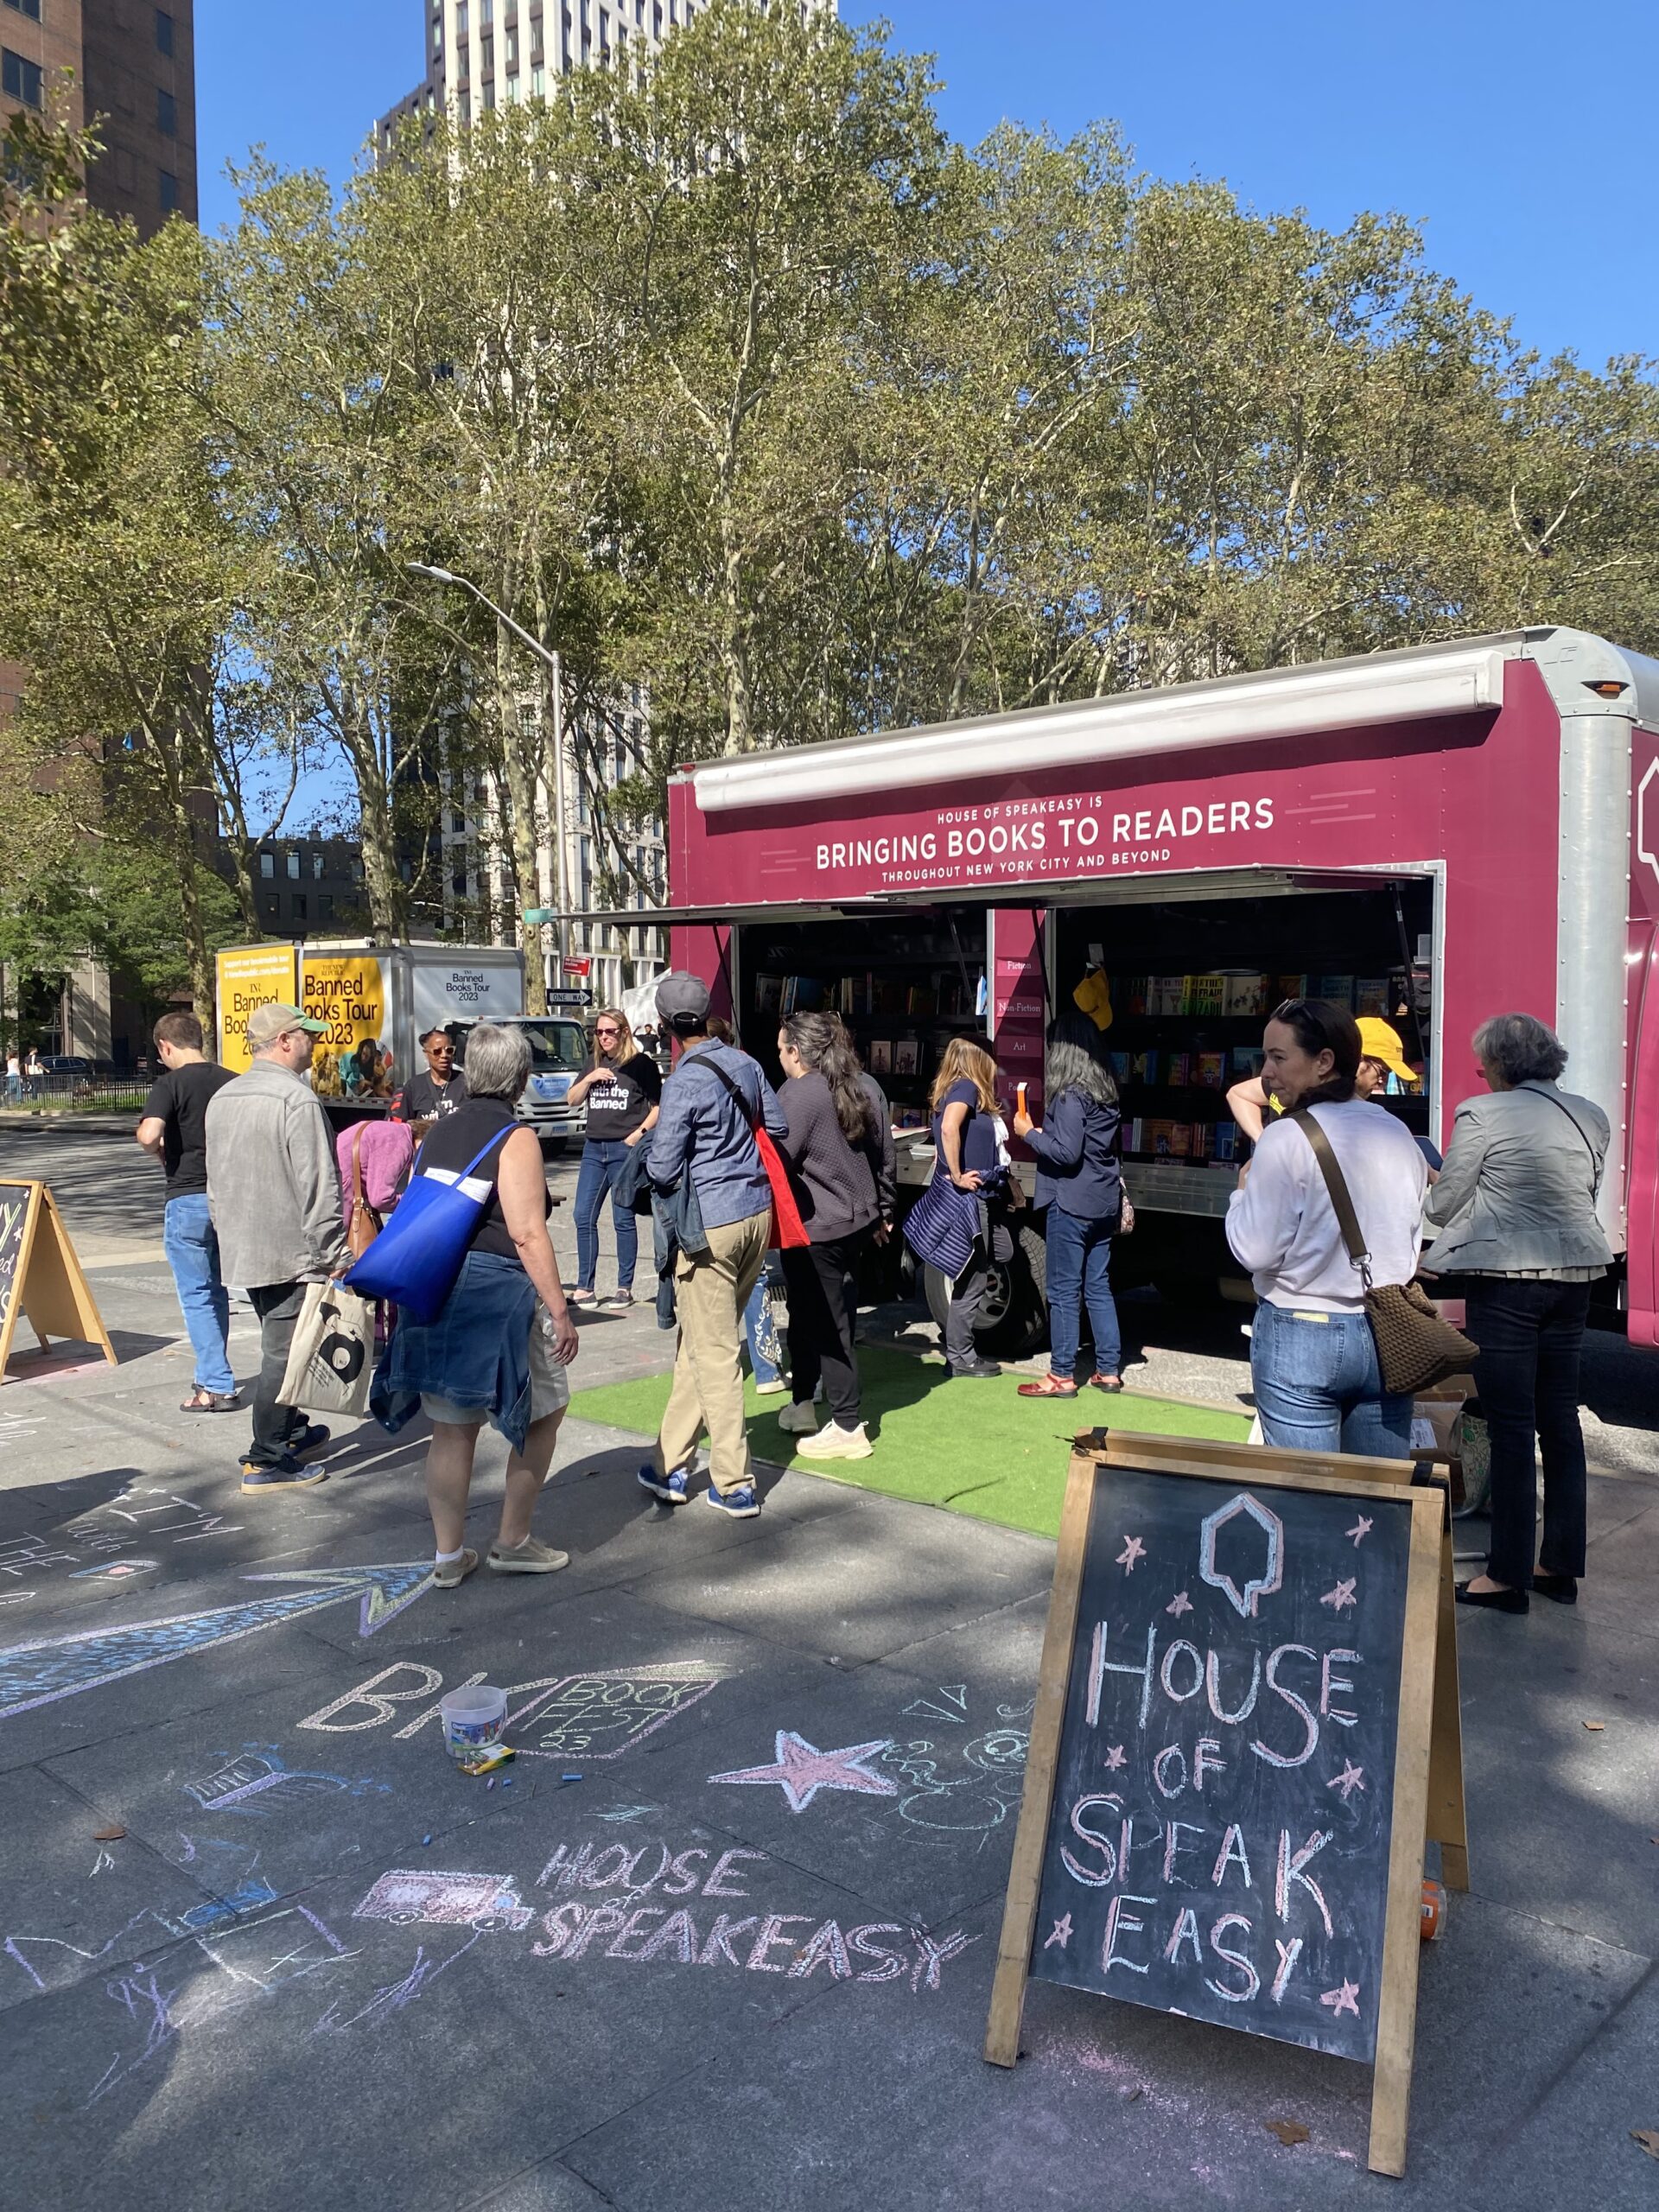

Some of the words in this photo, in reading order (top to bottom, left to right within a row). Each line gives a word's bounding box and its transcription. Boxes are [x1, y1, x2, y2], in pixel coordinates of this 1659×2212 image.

[938, 809, 979, 824] HOUSE
[983, 806, 1000, 819] OF
[1005, 798, 1083, 817] SPEAKEASY
[1089, 795, 1103, 808] IS
[816, 831, 937, 870] BRINGING
[947, 821, 1046, 857] BOOKS
[1058, 816, 1099, 846] TO
[1112, 798, 1275, 842] READERS
[881, 864, 962, 883] THROUGHOUT
[966, 862, 995, 876] NEW
[1000, 860, 1033, 874] YORK
[1039, 856, 1071, 870] CITY
[1077, 854, 1106, 868] AND
[1111, 849, 1171, 864] BEYOND
[453, 973, 484, 982] Banned
[1007, 961, 1032, 969] Fiction
[305, 972, 363, 996] Banned
[446, 982, 472, 992] Books
[473, 982, 490, 992] Tour
[459, 992, 479, 1001] 2023
[304, 997, 340, 1020] ooks
[342, 999, 378, 1020] Tour
[999, 1002, 1040, 1012] Non-Fiction
[1014, 1042, 1026, 1051] Art
[590, 1097, 627, 1110] Banned
[611, 1084, 629, 1098] the
[559, 1680, 707, 1707] BOOK
[1085, 1621, 1365, 1769] HOUSE
[518, 1702, 671, 1738] FEST
[539, 1733, 593, 1751] 23
[1153, 1738, 1228, 1800] OF
[533, 1842, 771, 1897] HOUSE
[1059, 1792, 1335, 1940] SPEAK
[529, 1900, 985, 1993] SPEAKEASY
[1100, 1894, 1305, 2004] EASY
